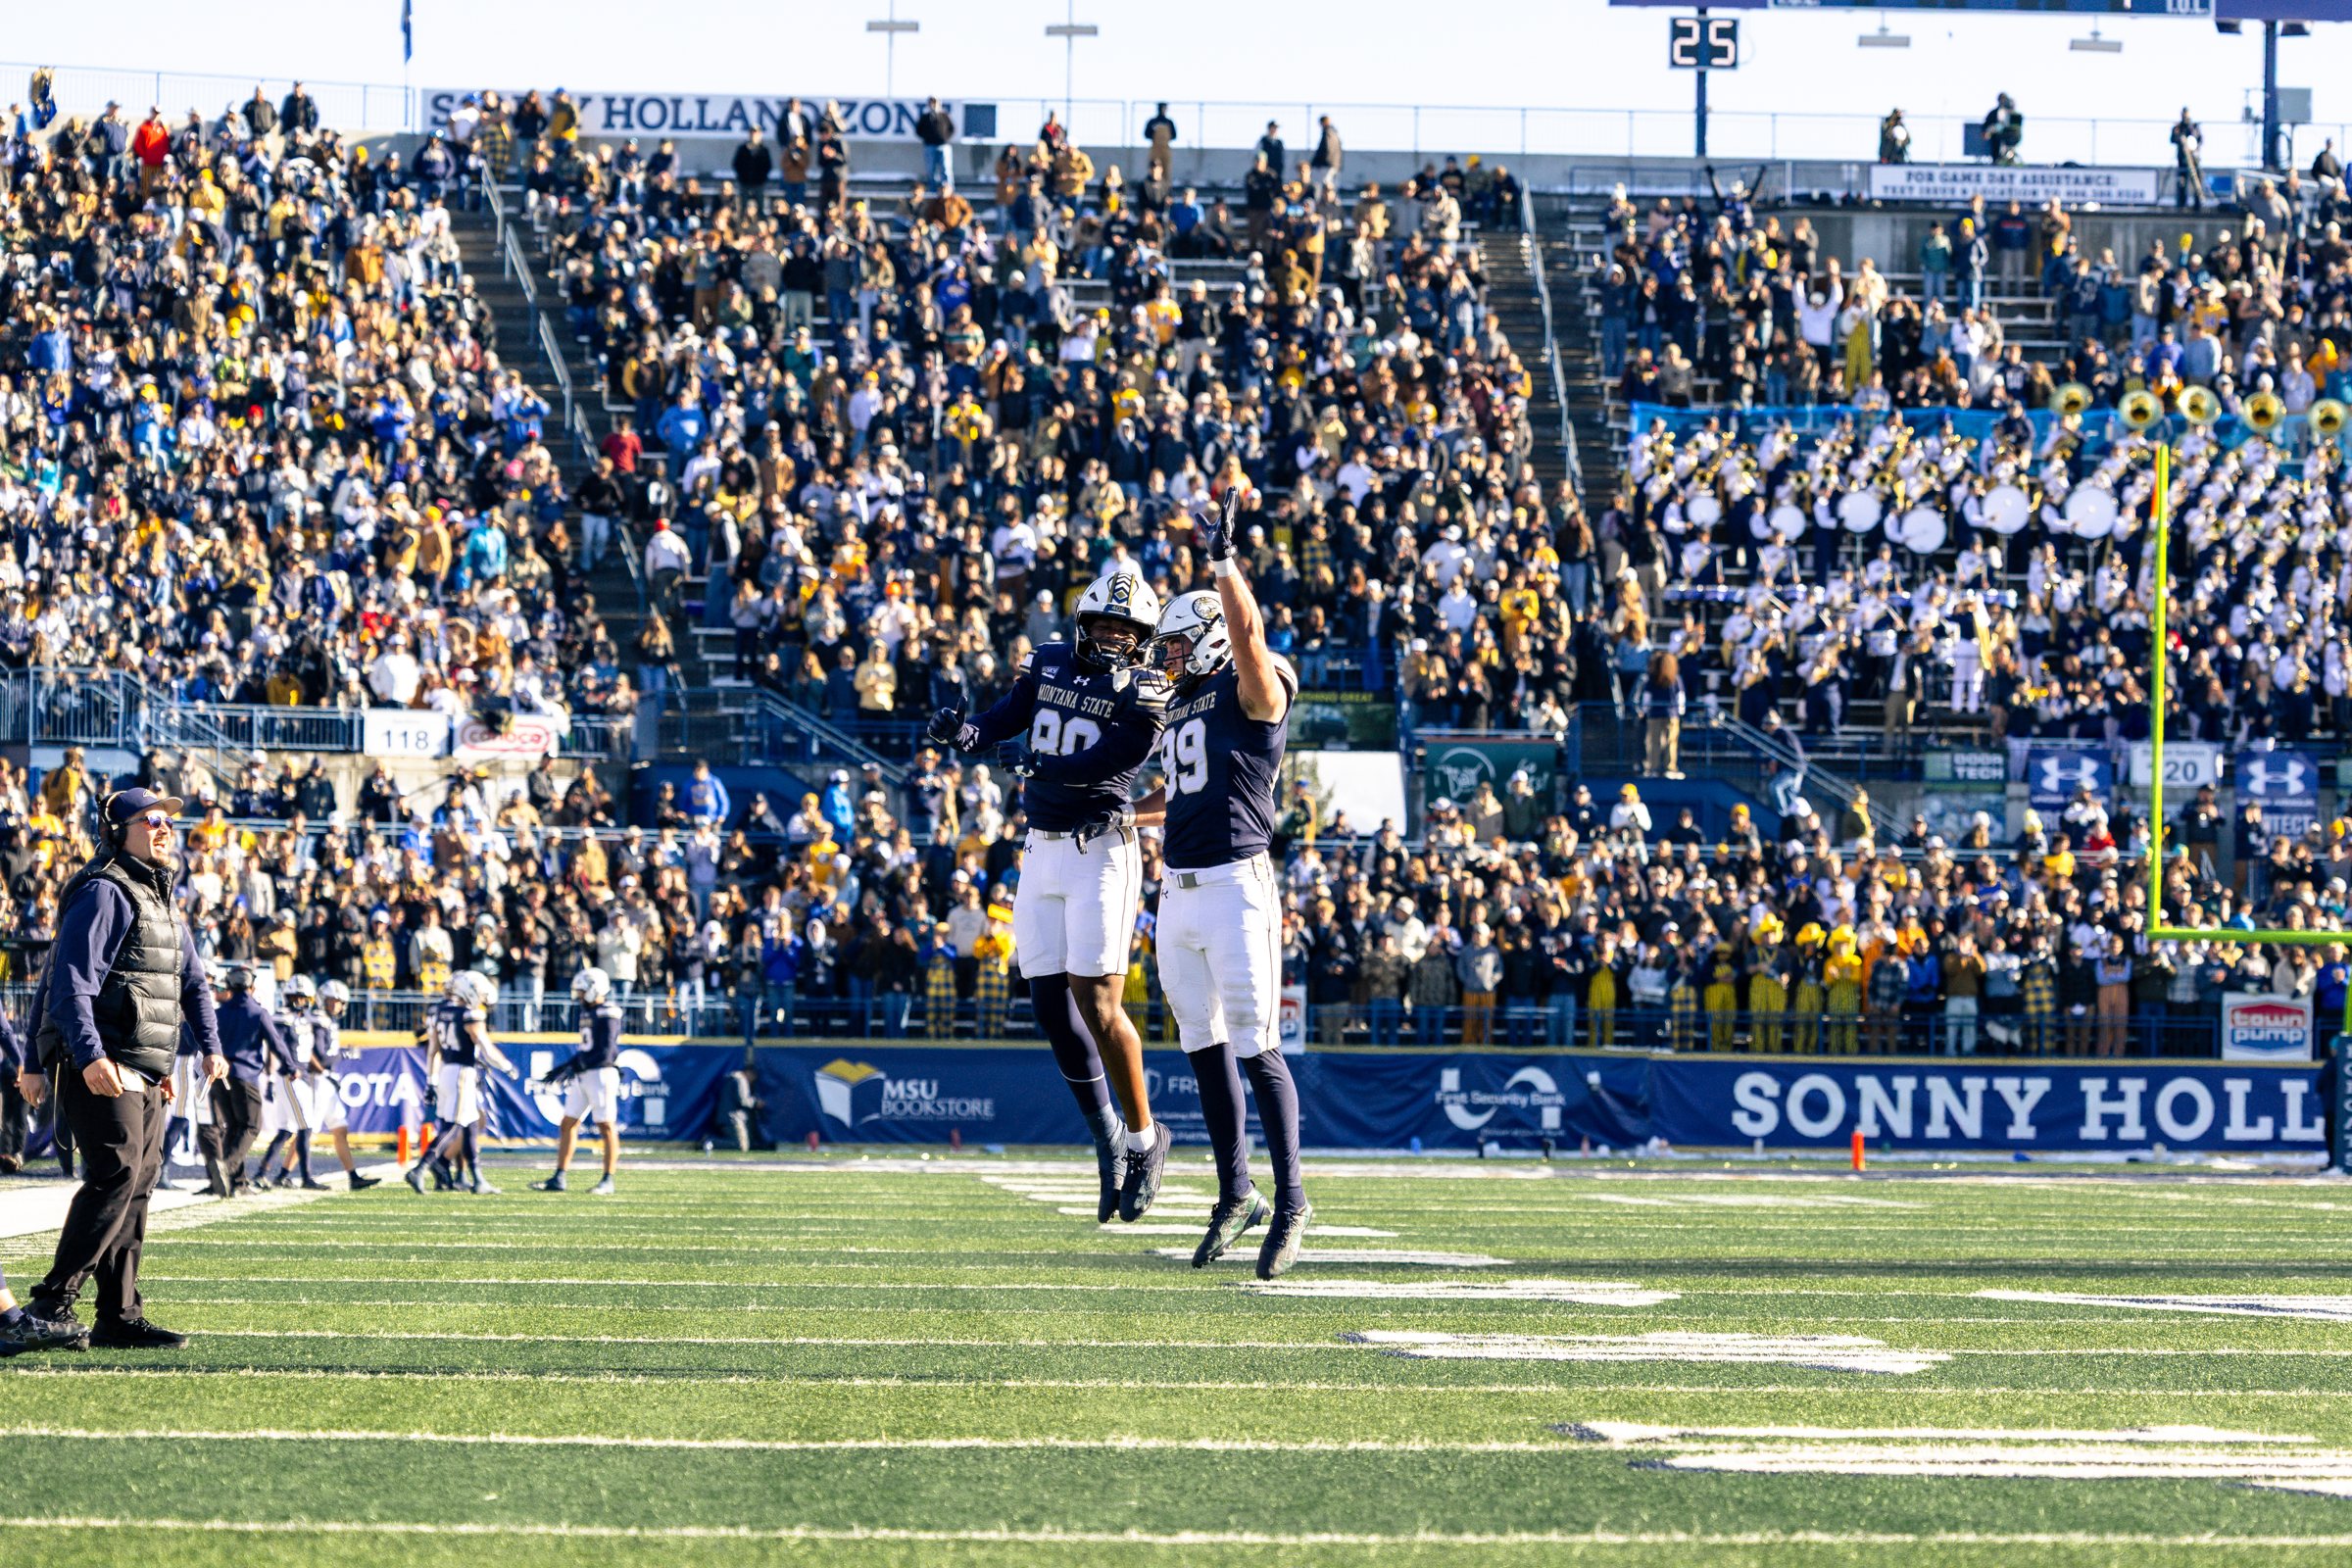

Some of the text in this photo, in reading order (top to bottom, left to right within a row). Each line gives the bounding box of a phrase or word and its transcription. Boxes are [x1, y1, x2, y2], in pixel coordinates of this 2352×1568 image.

[1672, 19, 1737, 66] 25
[836, 102, 951, 134] ZON
[1905, 171, 1935, 183] FOR
[1938, 171, 1982, 184] GAME
[1986, 172, 2015, 184] DAY
[1037, 684, 1115, 718] MONTANA STATE
[1166, 703, 1192, 725] ONTANA
[1191, 691, 1217, 715] STATE
[383, 729, 429, 751] 118
[1954, 766, 2005, 781] TECH
[2148, 760, 2198, 783] 20
[2233, 1010, 2303, 1028] town
[2234, 1027, 2303, 1044] pump
[339, 1071, 420, 1108] OTA
[631, 1079, 670, 1097] Bank
[882, 1079, 939, 1101] MSU
[882, 1100, 995, 1117] BOOKSTORE
[1435, 1091, 1566, 1108] First Security Bank
[1731, 1072, 2051, 1141] SONNY
